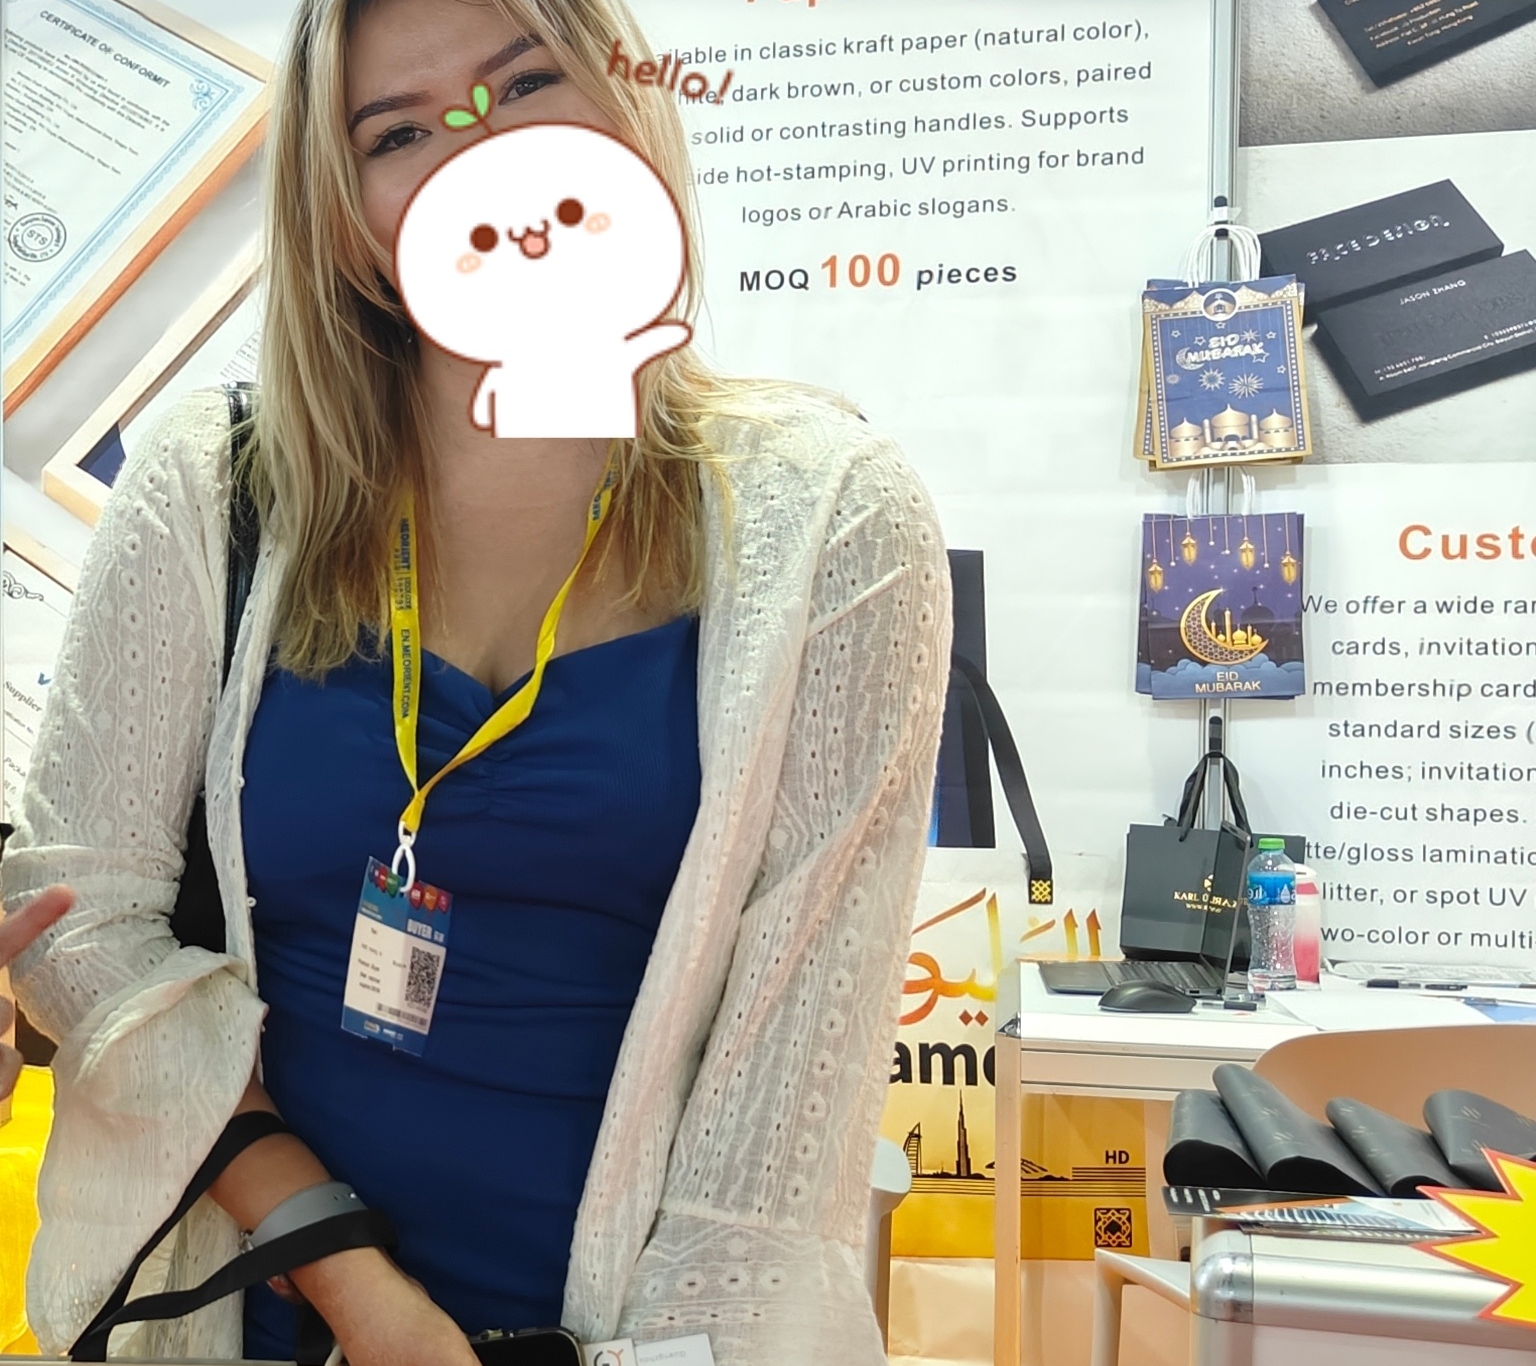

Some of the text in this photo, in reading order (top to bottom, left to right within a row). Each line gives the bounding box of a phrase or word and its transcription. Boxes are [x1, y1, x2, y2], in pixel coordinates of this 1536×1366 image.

[40, 10, 99, 47] CERTIFICATE
[99, 43, 113, 54] OF
[734, 18, 1150, 61] in classic kraft paper (natural color),
[732, 61, 1152, 102] dark brown, or custom colors, paired
[691, 105, 1130, 145] solid or contrasting handles. Supports
[696, 147, 1145, 185] ide hot-stamping, UV printing for brand
[742, 195, 1017, 227] logos or Arabic slogans.
[27, 229, 48, 246] STS
[739, 253, 1018, 294] MOQ 100 pieces
[1400, 279, 1467, 306] JASON ZHANG
[1208, 333, 1240, 348] EID
[1185, 342, 1264, 363] MUBARAK
[1399, 524, 1536, 561] Cust
[1302, 595, 1495, 614] We offer a wide
[1331, 637, 1409, 659] cards,
[1195, 680, 1261, 694] MUBARAK
[1217, 671, 1239, 683] EID
[1313, 679, 1472, 702] membership
[1328, 720, 1517, 739] standard sizes
[1321, 760, 1412, 783] inches;
[1330, 801, 1527, 826] die-cut shapes.
[1305, 841, 1414, 865] tte/gloss
[1174, 891, 1199, 901] KARL
[1322, 882, 1527, 909] litter, or spot UV
[1321, 926, 1536, 949] wo-color or multi
[1105, 1149, 1130, 1165] HD
